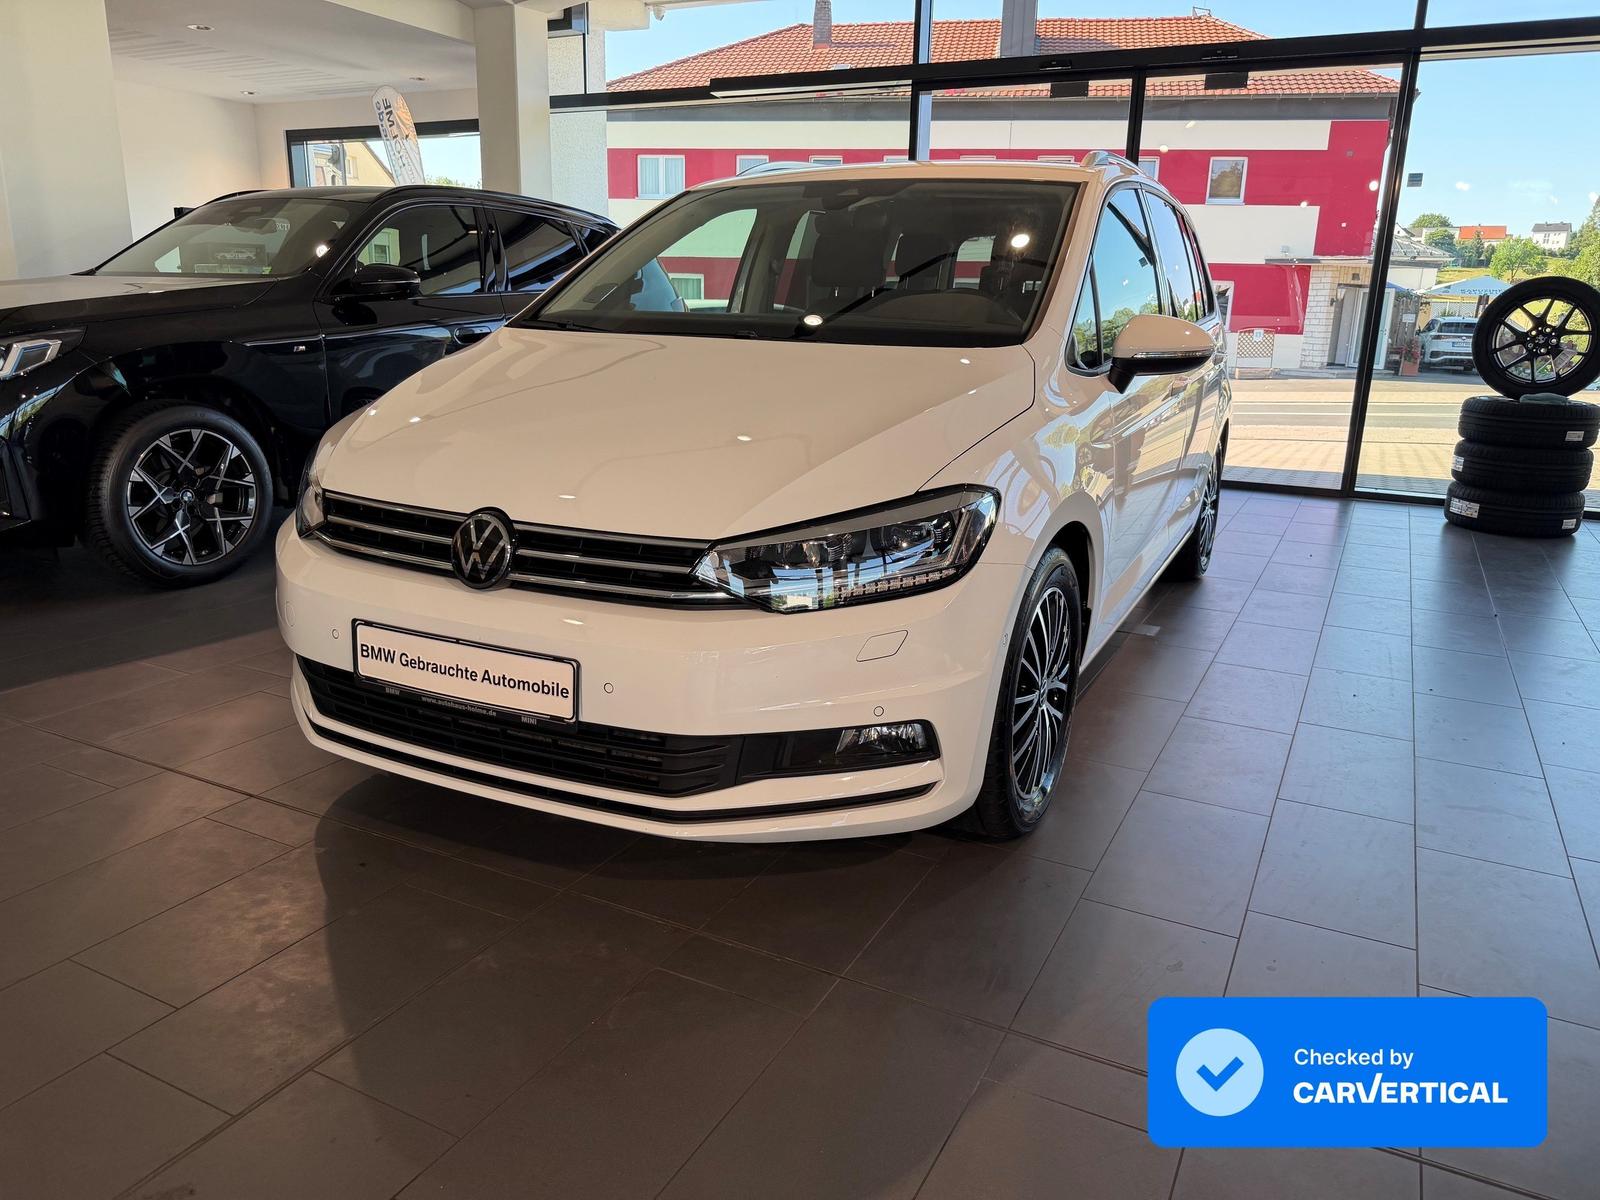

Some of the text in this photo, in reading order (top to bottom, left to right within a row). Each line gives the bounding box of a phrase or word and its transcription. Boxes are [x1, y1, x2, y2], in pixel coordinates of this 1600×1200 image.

[360, 643, 570, 699] BMW Gebrauchte Automobile
[385, 687, 401, 696] BMW
[521, 715, 538, 725] MINI
